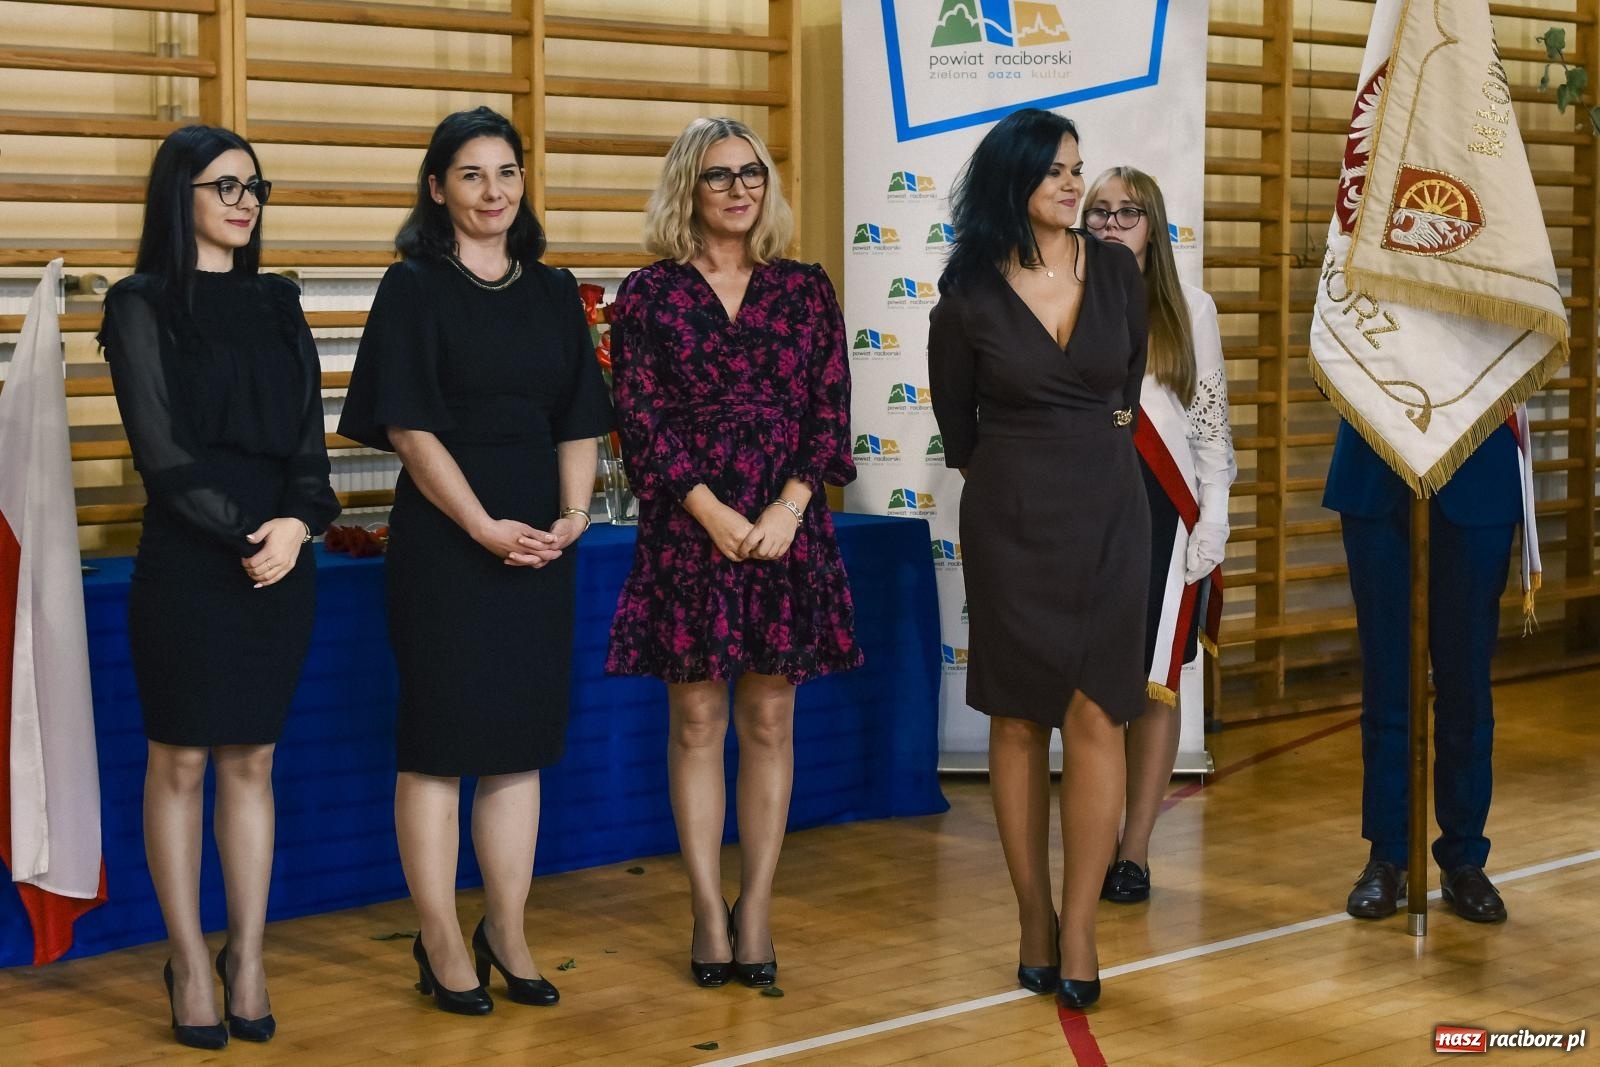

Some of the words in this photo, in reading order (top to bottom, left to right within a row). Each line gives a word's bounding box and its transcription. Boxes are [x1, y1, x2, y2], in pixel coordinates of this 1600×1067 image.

[929, 51, 984, 69] powiat
[995, 50, 1072, 65] raciborski
[929, 70, 977, 79] zielona
[987, 71, 1021, 79] oaza
[1031, 70, 1071, 79] kultur
